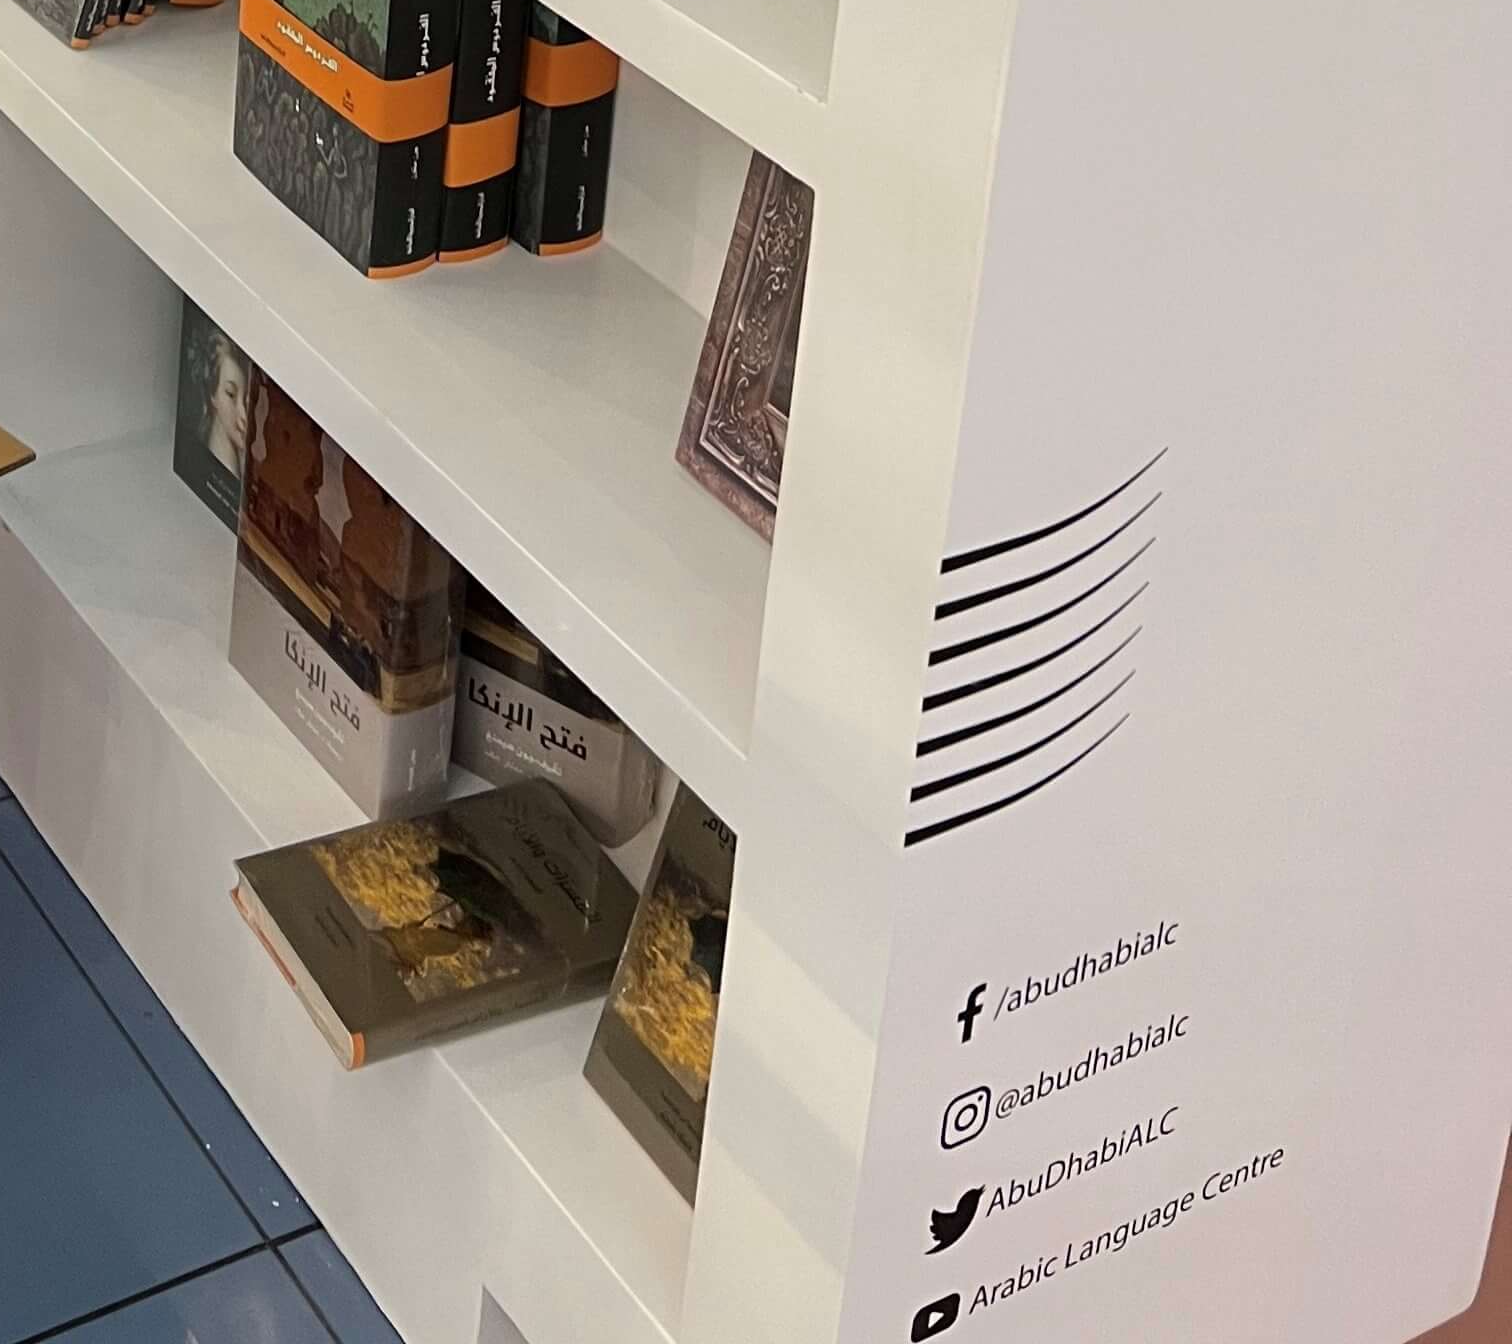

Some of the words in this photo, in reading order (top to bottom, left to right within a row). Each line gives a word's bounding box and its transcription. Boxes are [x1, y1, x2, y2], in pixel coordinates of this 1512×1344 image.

[329, 689, 361, 732] فتح
[468, 676, 534, 732] الإنكا
[538, 722, 588, 762] فتح
[993, 921, 1179, 1021] /abudhabialc
[995, 1014, 1189, 1120] @abudhabialc
[986, 1106, 1180, 1218] AbuDhabiALC
[969, 1255, 1059, 1315] Arabic
[1064, 1191, 1195, 1271] Language
[1202, 1147, 1285, 1202] Centre
